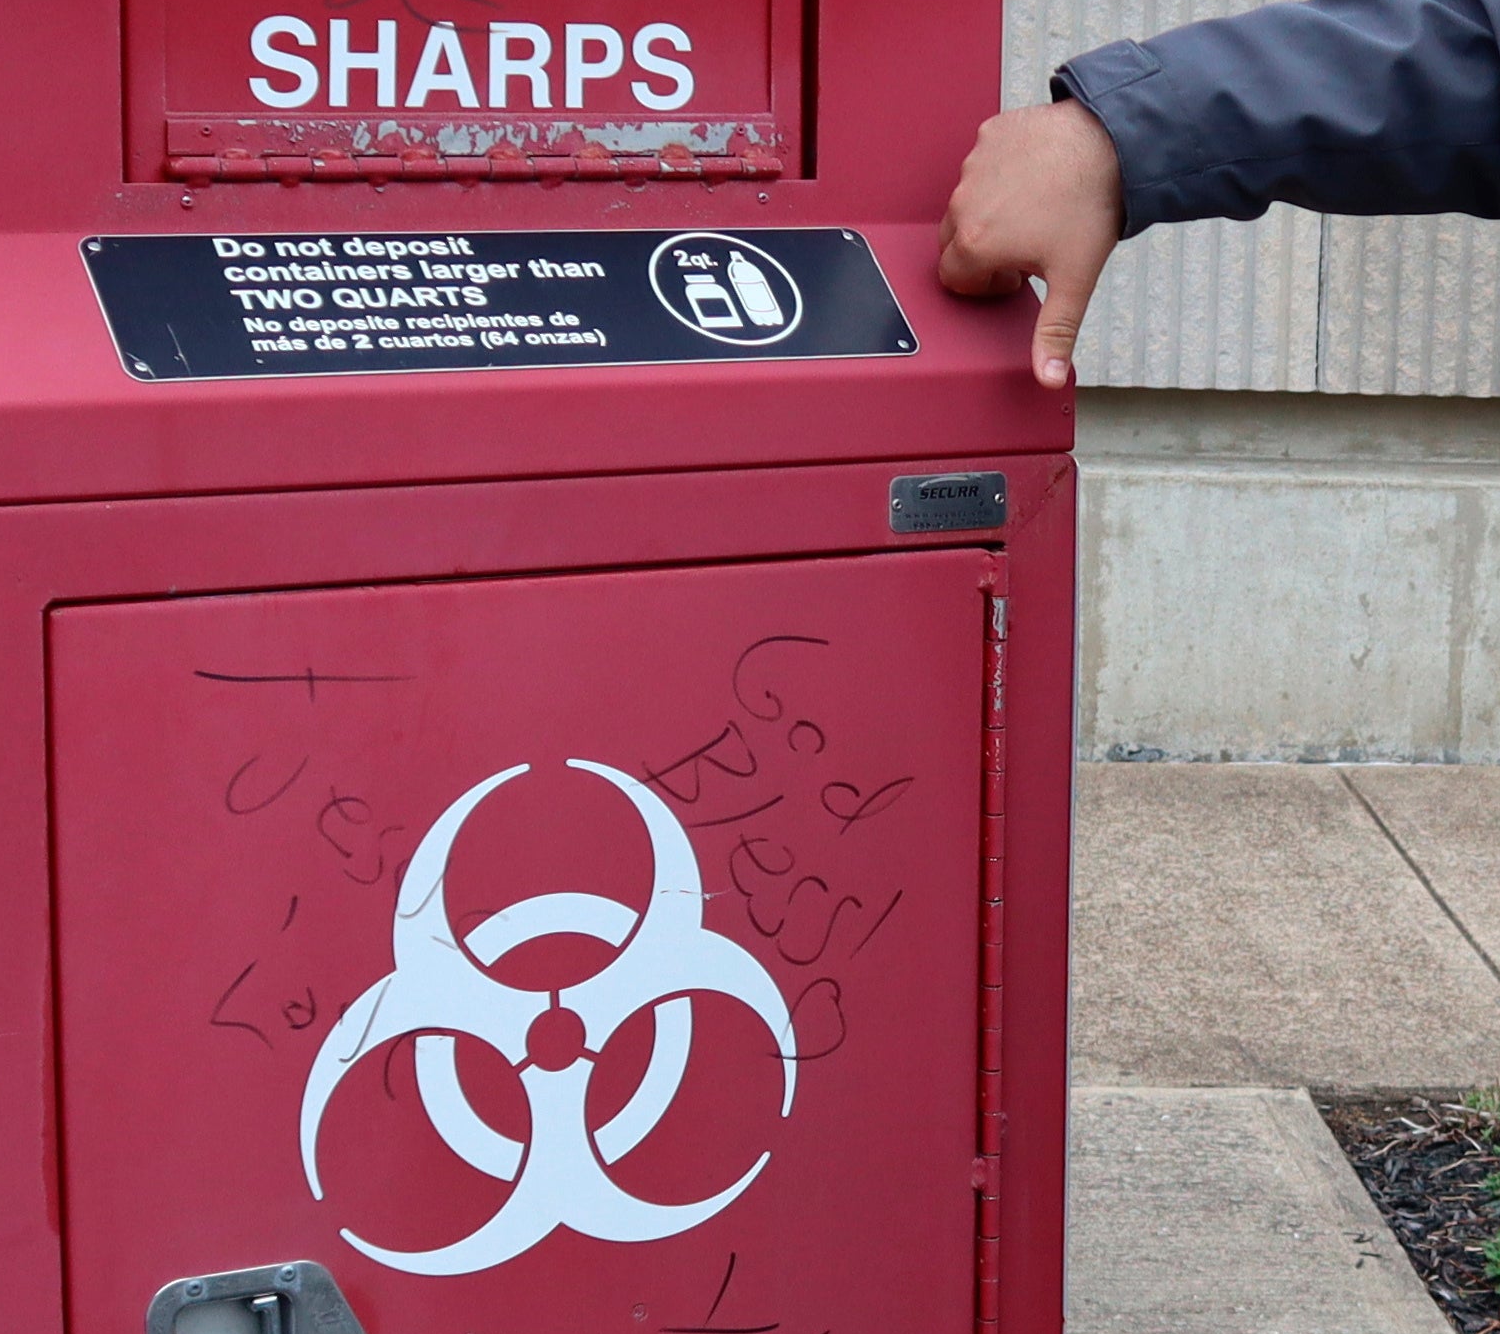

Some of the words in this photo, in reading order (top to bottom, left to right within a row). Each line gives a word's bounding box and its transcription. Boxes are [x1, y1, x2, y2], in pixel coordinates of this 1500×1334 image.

[249, 15, 694, 111] SHARPS
[211, 237, 266, 258] Do
[274, 237, 337, 257] not
[342, 236, 475, 261] deposit
[673, 249, 719, 270] 2qt.
[223, 260, 413, 283] containers
[418, 259, 521, 284] larger
[527, 258, 606, 279] than
[229, 288, 323, 310] TWO
[331, 285, 488, 310] QUARTS
[242, 317, 283, 333] No
[288, 314, 400, 335] deposite
[404, 313, 544, 332] recipientes
[548, 311, 581, 327] de
[251, 335, 309, 352] más
[314, 334, 348, 351] de
[351, 333, 374, 350] 2
[378, 332, 475, 349] cuartos
[479, 330, 520, 350] (64
[524, 328, 607, 347] onzas)
